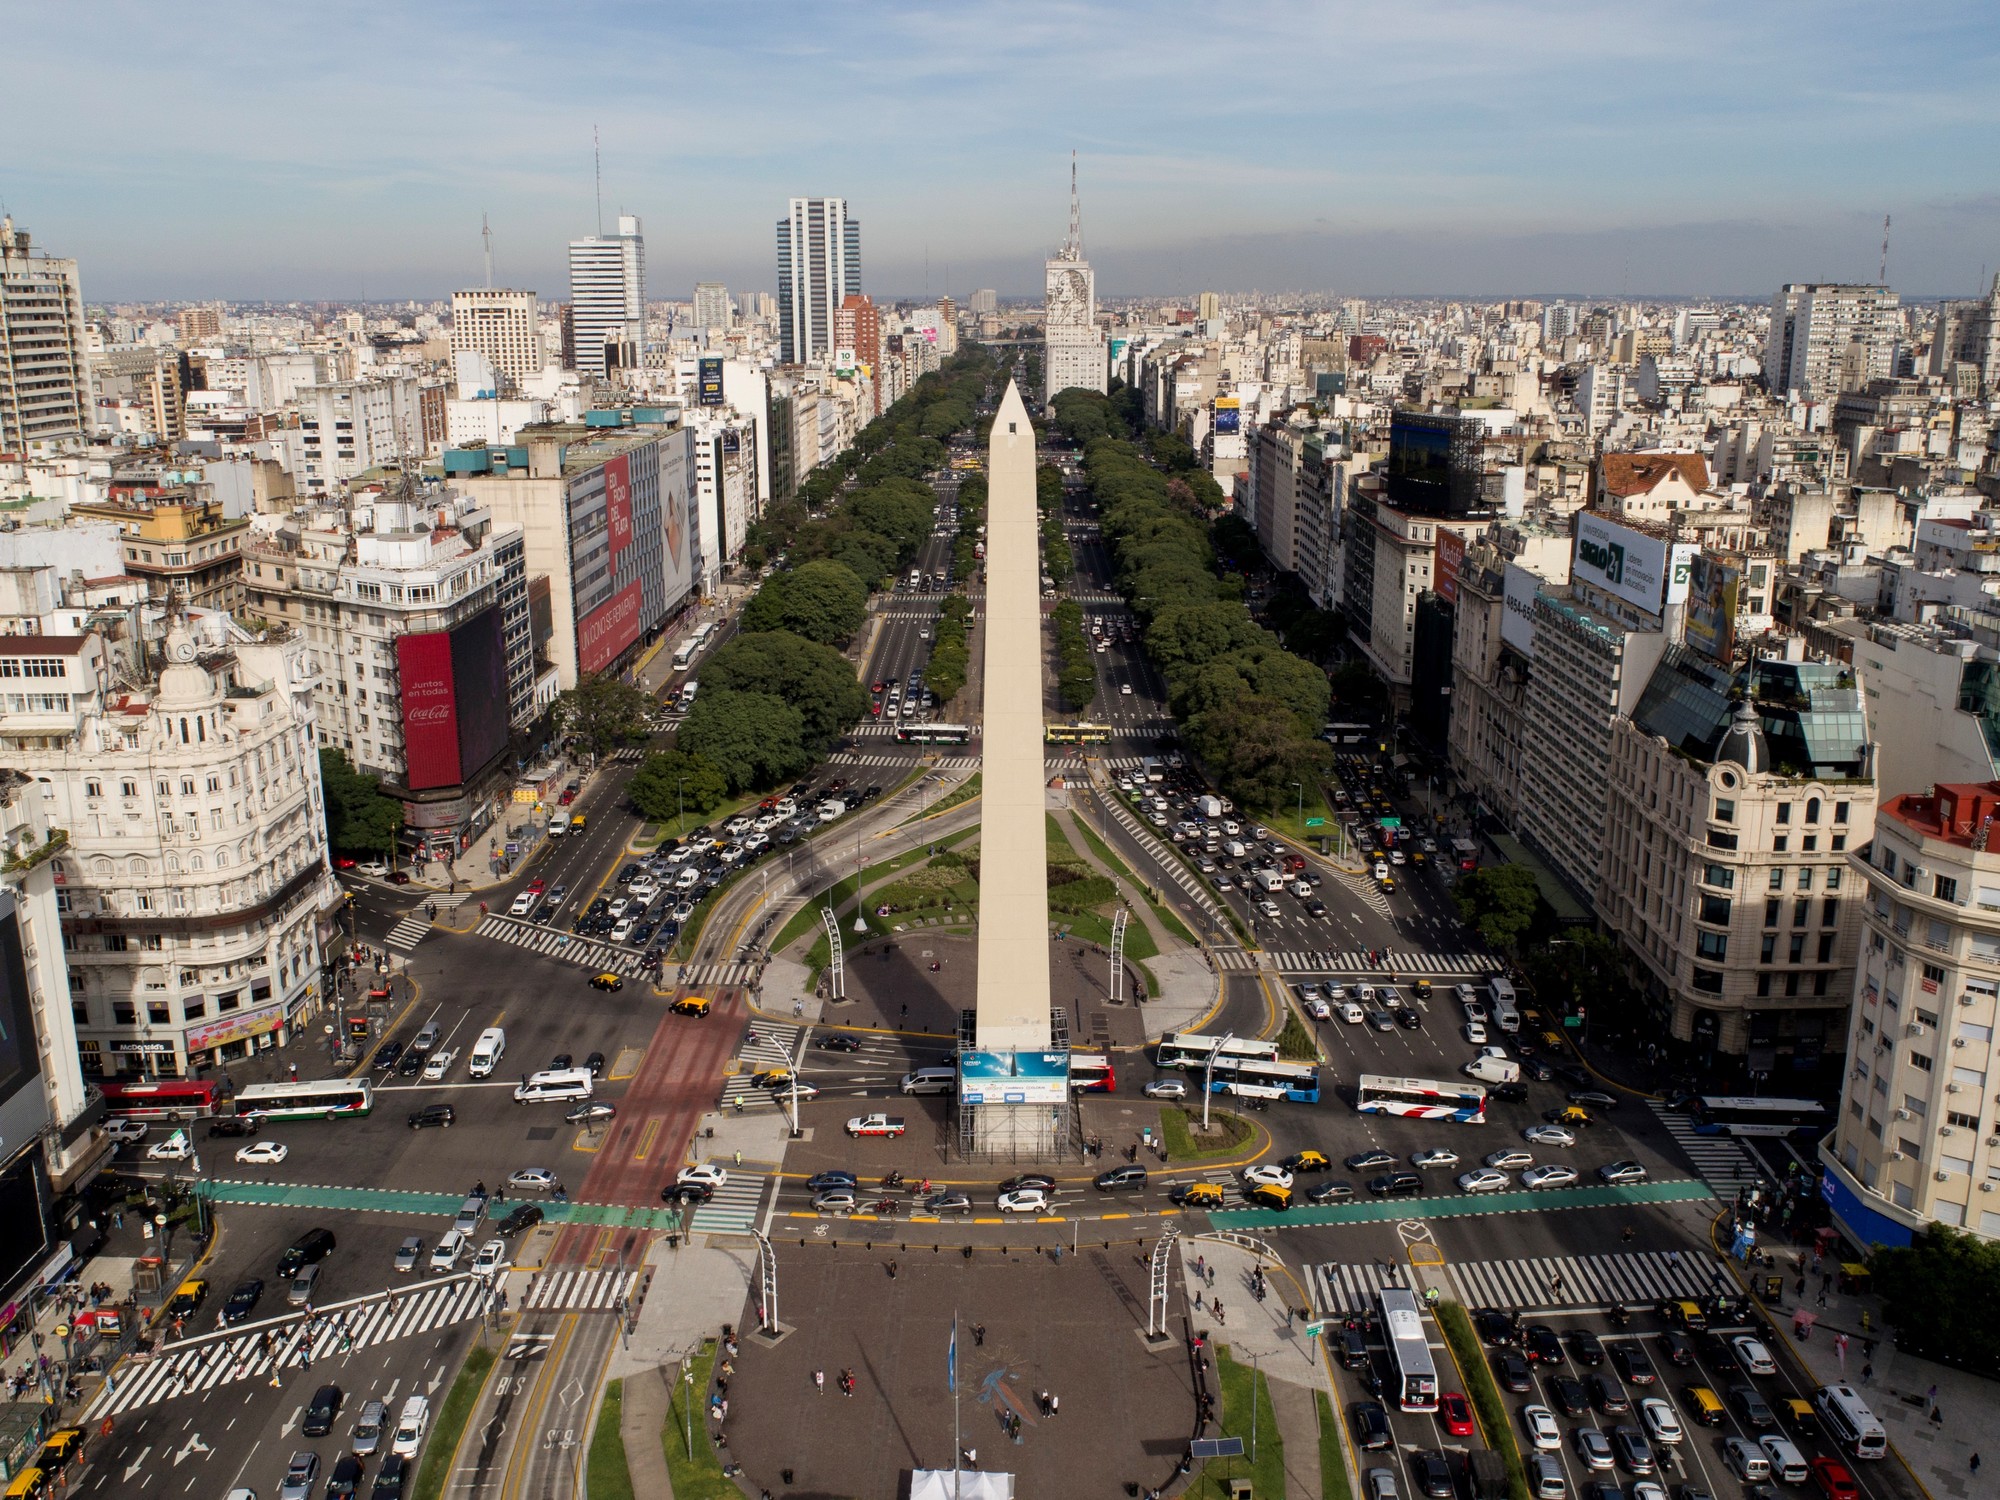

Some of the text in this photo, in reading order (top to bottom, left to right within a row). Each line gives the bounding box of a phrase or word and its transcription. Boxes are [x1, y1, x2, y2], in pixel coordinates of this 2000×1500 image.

[841, 352, 851, 360] 10
[610, 504, 620, 522] DEL
[614, 516, 629, 537] PLATA
[1582, 523, 1610, 542] UNIVERSIDAD
[1578, 538, 1608, 570] SIGLO
[1626, 551, 1643, 567] Líderes
[1631, 565, 1655, 584] innovación
[1676, 567, 1690, 585] 21
[412, 681, 444, 689] Juntos
[422, 687, 449, 696] todas
[119, 1043, 165, 1051] McDonald's
